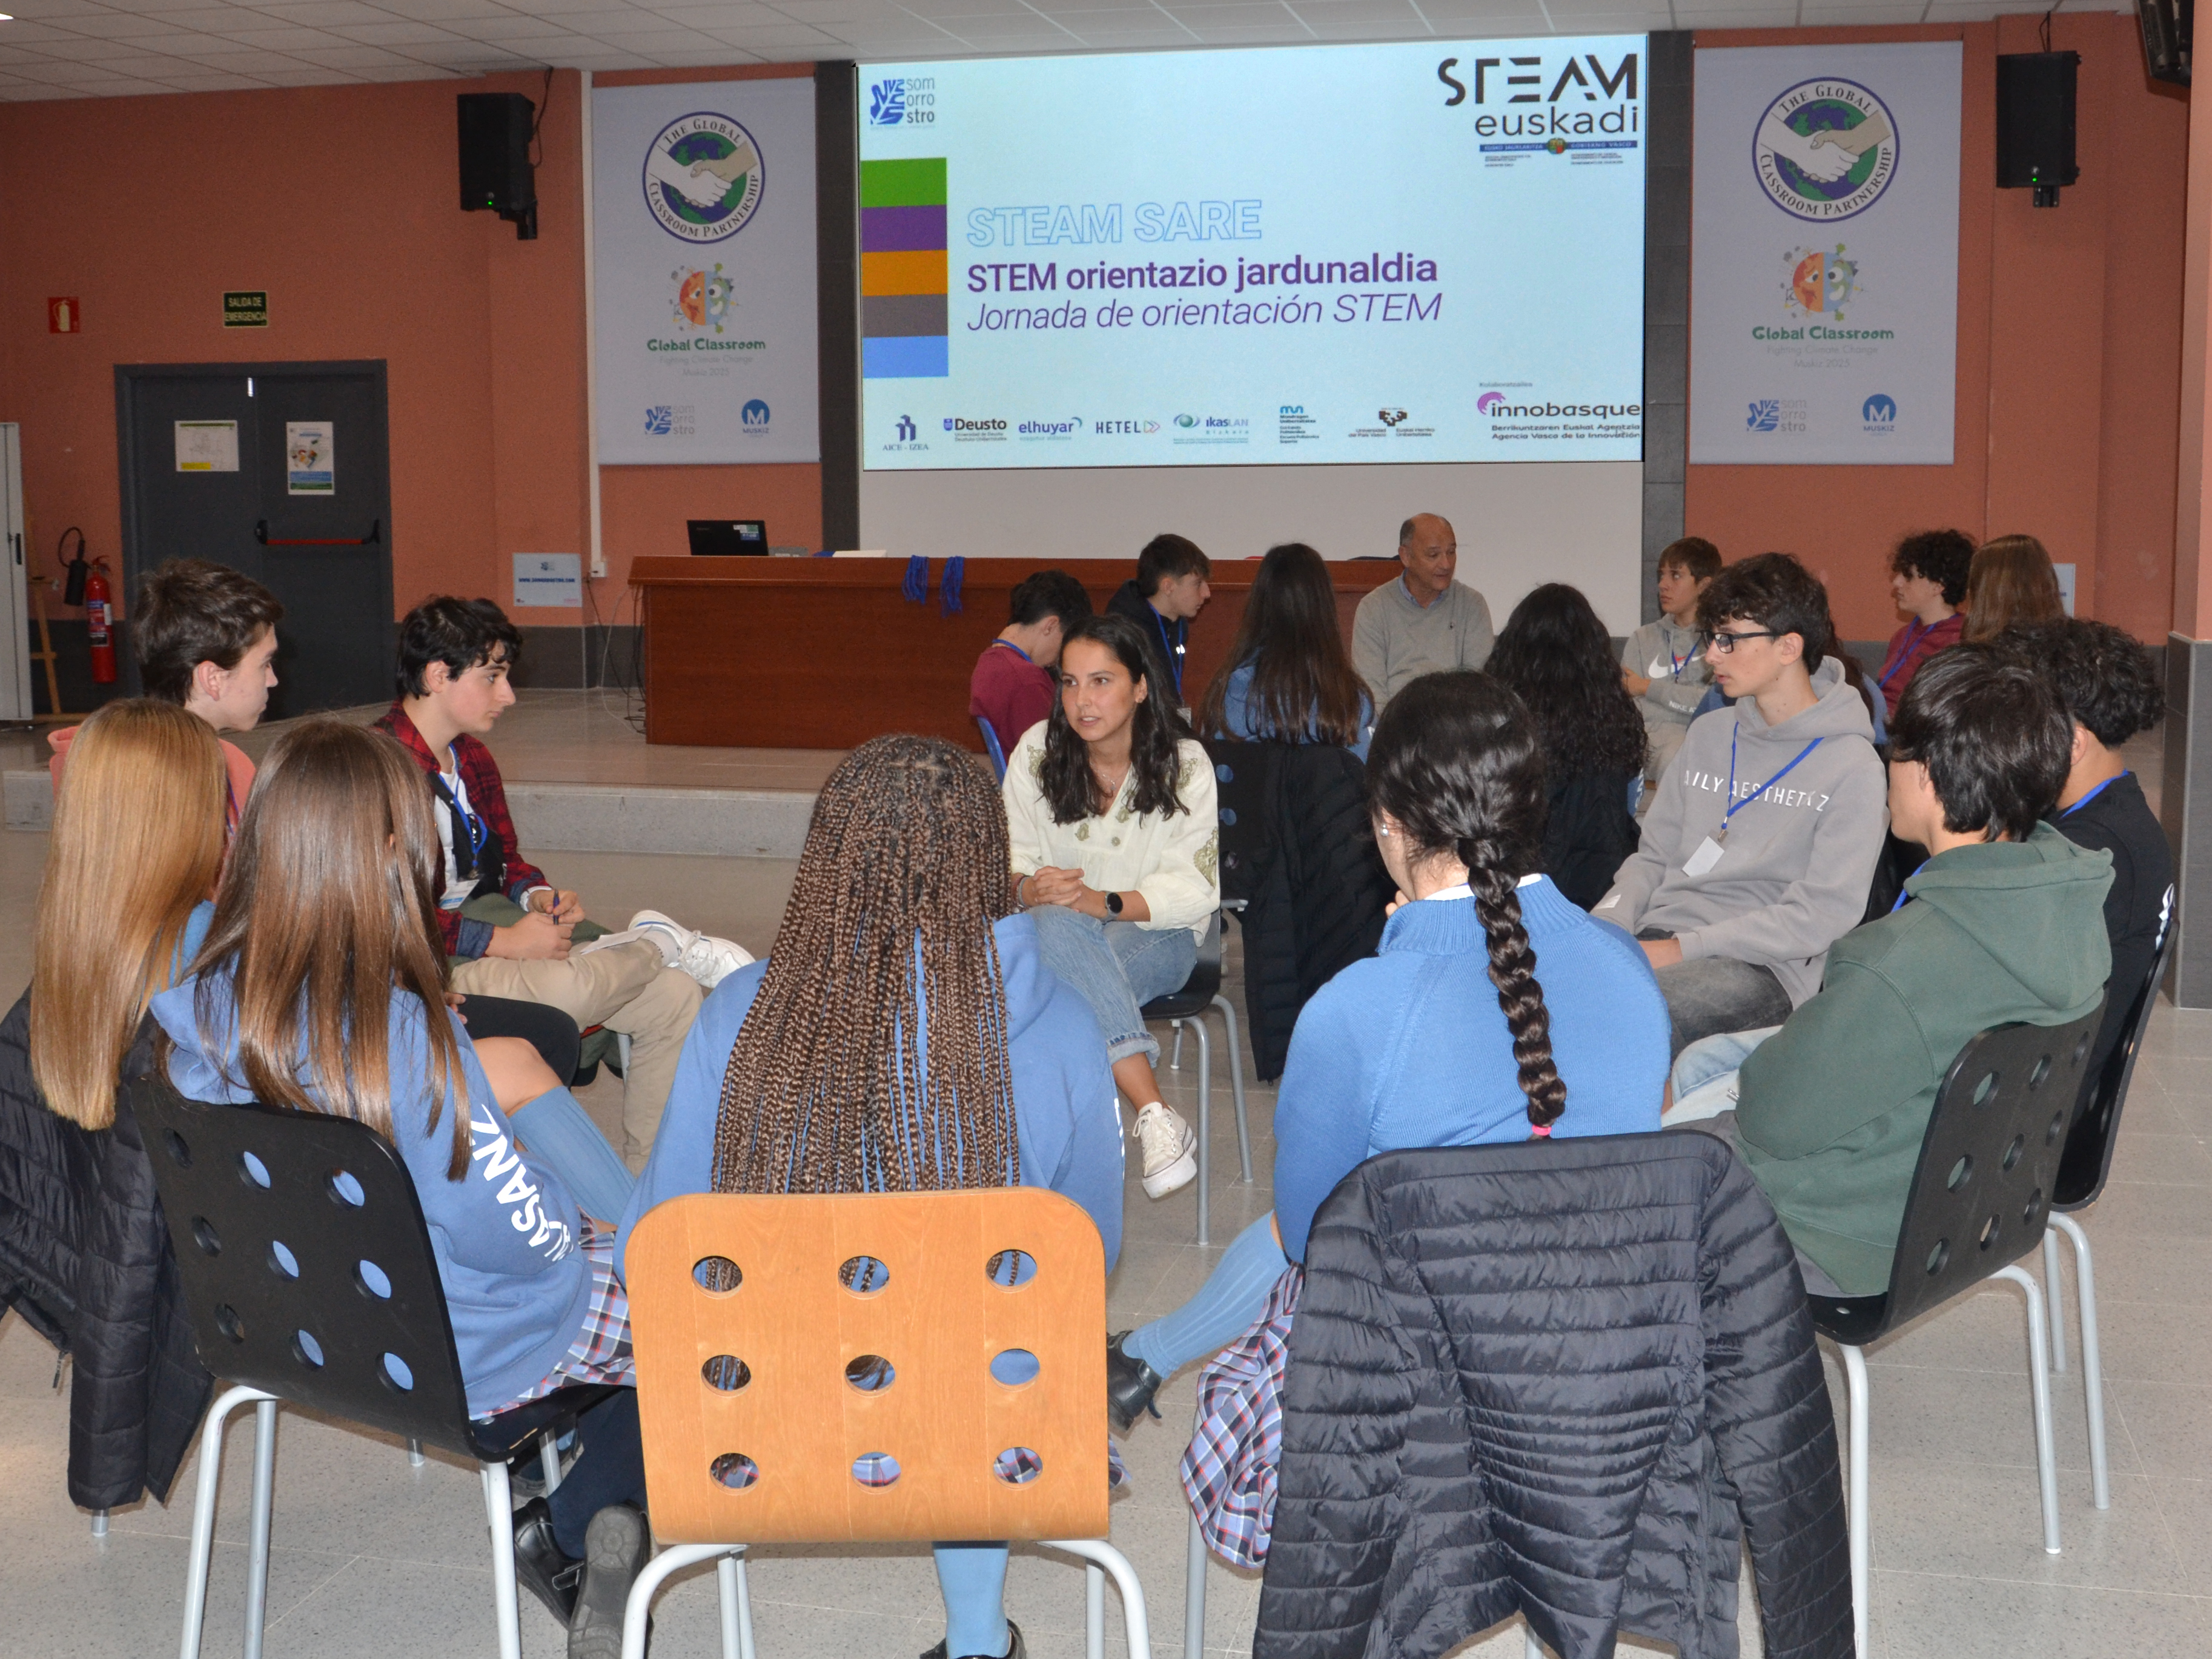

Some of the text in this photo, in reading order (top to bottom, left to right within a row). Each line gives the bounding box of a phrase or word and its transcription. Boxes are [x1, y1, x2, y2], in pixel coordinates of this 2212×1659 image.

[907, 78, 935, 91] som
[1437, 53, 1637, 107] STEAM
[907, 93, 935, 107] orro
[1778, 84, 1872, 114] THE GLOBAL
[907, 108, 935, 124] stro
[1475, 104, 1638, 137] euskadi
[663, 118, 742, 145] THE GLOBAL
[1760, 147, 1892, 216] CLASSROOM PARTNERSHIP
[648, 174, 760, 237] CLASSROOM PARTNERSHIP
[967, 200, 1262, 247] STEAM SARE
[967, 253, 1438, 294] STEM orientazio jardunaldia
[228, 296, 262, 307] SALIDA DE
[225, 311, 267, 322] EMERGENCIA
[967, 293, 1443, 331] Jornada de orientación STEM
[1752, 325, 1895, 340] Global Classroom
[646, 337, 766, 351] Global Classroom
[1491, 402, 1641, 420] innobasque
[673, 425, 695, 435] stro
[954, 417, 1007, 431] Deusto
[1018, 421, 1074, 435] elhuyar
[1095, 420, 1141, 434] HETEL
[1780, 422, 1806, 432] stro
[1669, 700, 1687, 712] NIKE
